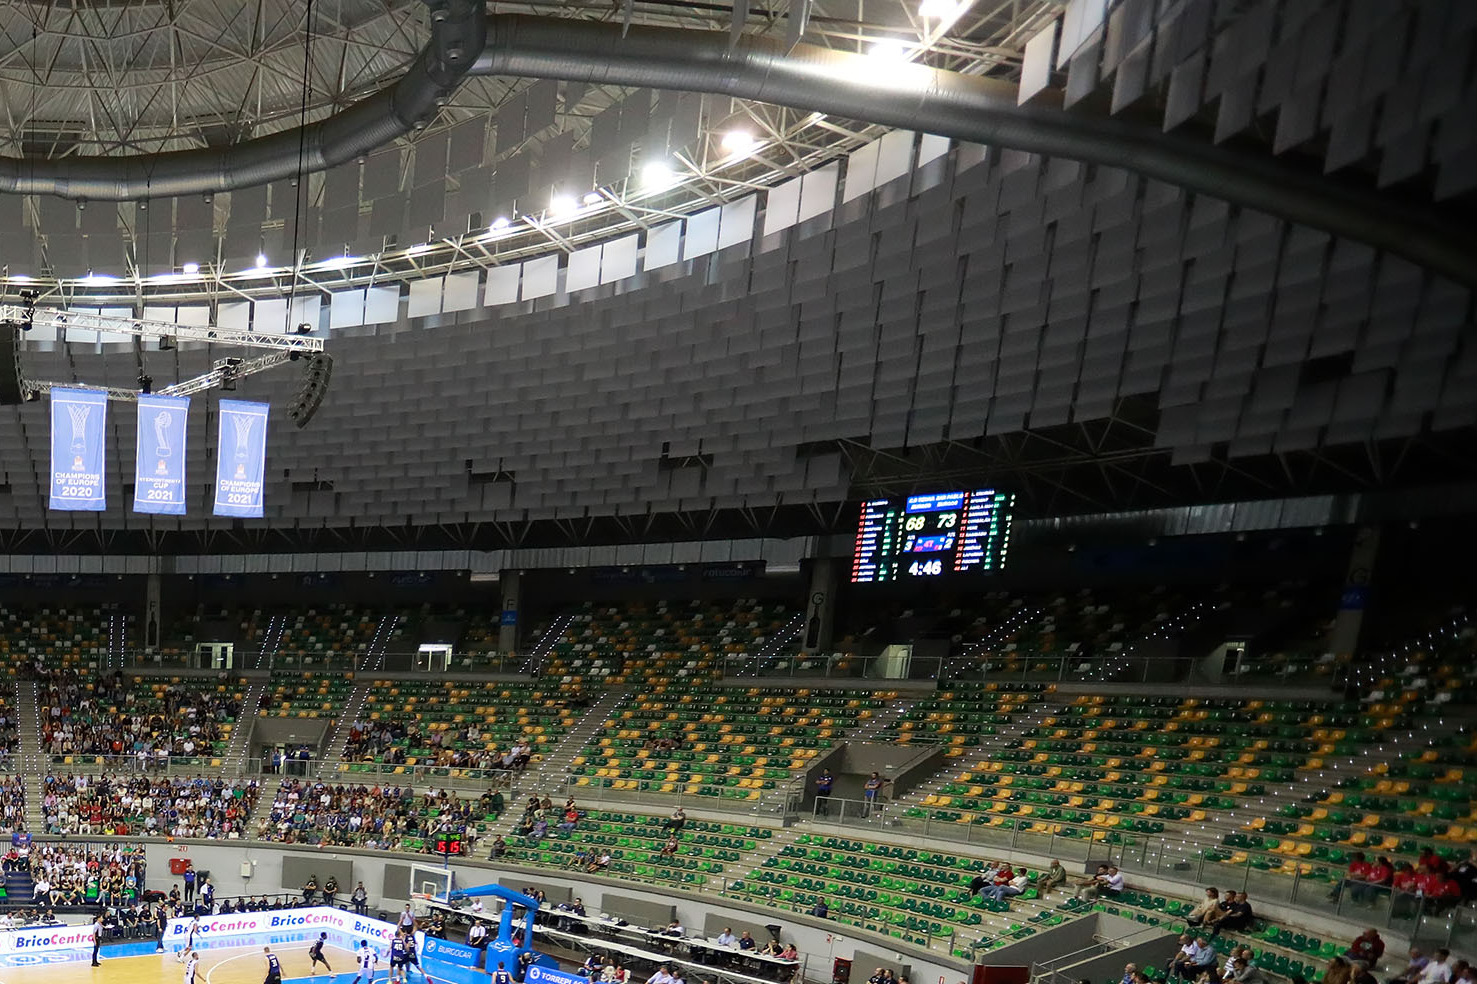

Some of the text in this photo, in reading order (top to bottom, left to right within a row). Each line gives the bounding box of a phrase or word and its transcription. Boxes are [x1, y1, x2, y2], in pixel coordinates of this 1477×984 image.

[54, 472, 100, 480] CHAMPIONS
[62, 486, 92, 496] 2020
[148, 490, 172, 500] 2021
[228, 494, 252, 504] 2021
[906, 516, 926, 531] 68
[937, 513, 956, 528] 73
[904, 541, 913, 551] 3
[944, 538, 954, 550] 2
[908, 560, 942, 576] 4:46
[812, 592, 824, 605] G
[271, 913, 344, 927] BricoCentro
[438, 945, 473, 960] BURGOCAR
